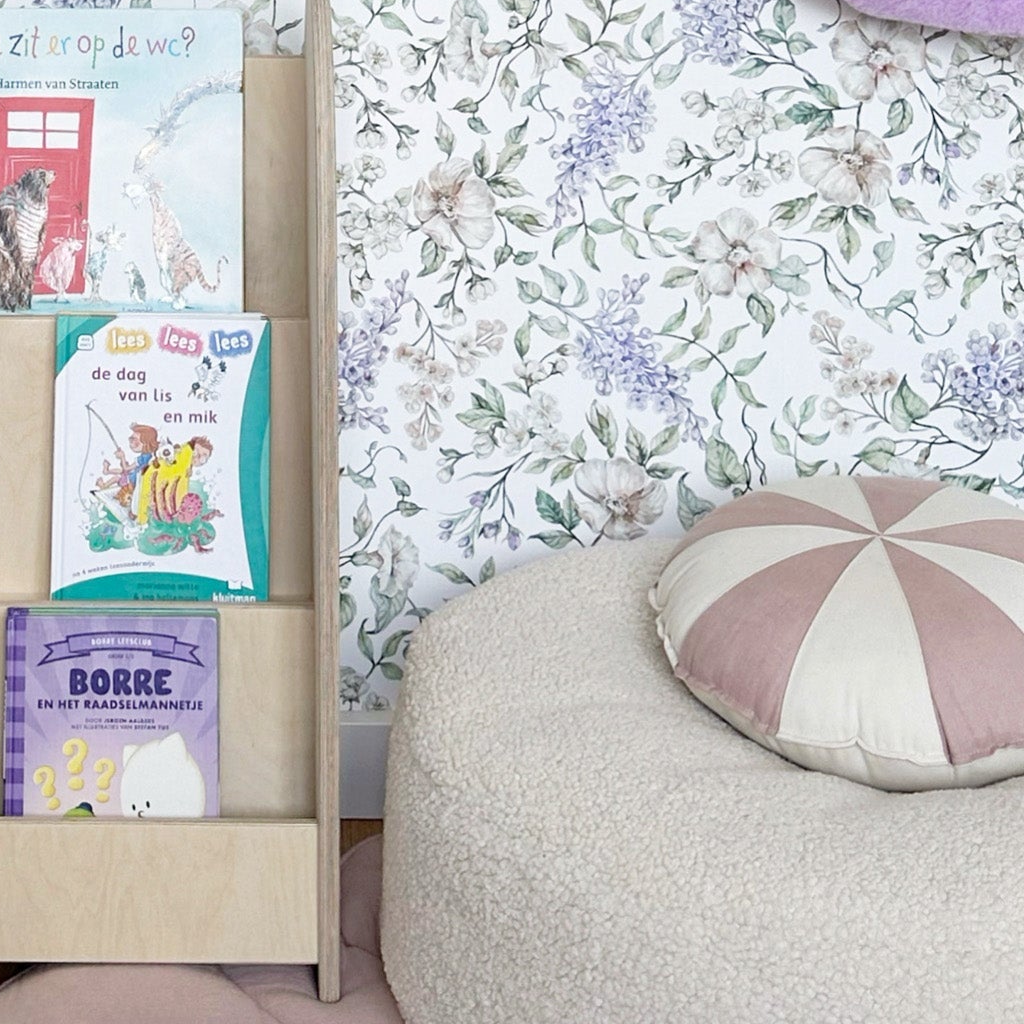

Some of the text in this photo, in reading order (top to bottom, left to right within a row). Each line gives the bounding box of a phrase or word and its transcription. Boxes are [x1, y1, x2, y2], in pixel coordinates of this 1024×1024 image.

[9, 26, 40, 58] zit
[46, 35, 71, 57] er
[77, 35, 105, 69] op
[112, 26, 140, 58] de
[146, 26, 196, 58] wc?
[45, 80, 66, 89] van
[68, 78, 119, 89] Straaten
[112, 332, 145, 349] lees
[164, 327, 197, 351] lees
[215, 332, 249, 352] lees
[92, 367, 146, 385] de dag
[119, 389, 172, 402] van lis
[164, 410, 218, 424] en mik
[69, 668, 172, 696] BORRE
[37, 699, 204, 711] EN HET RAADSELMANNETJE
